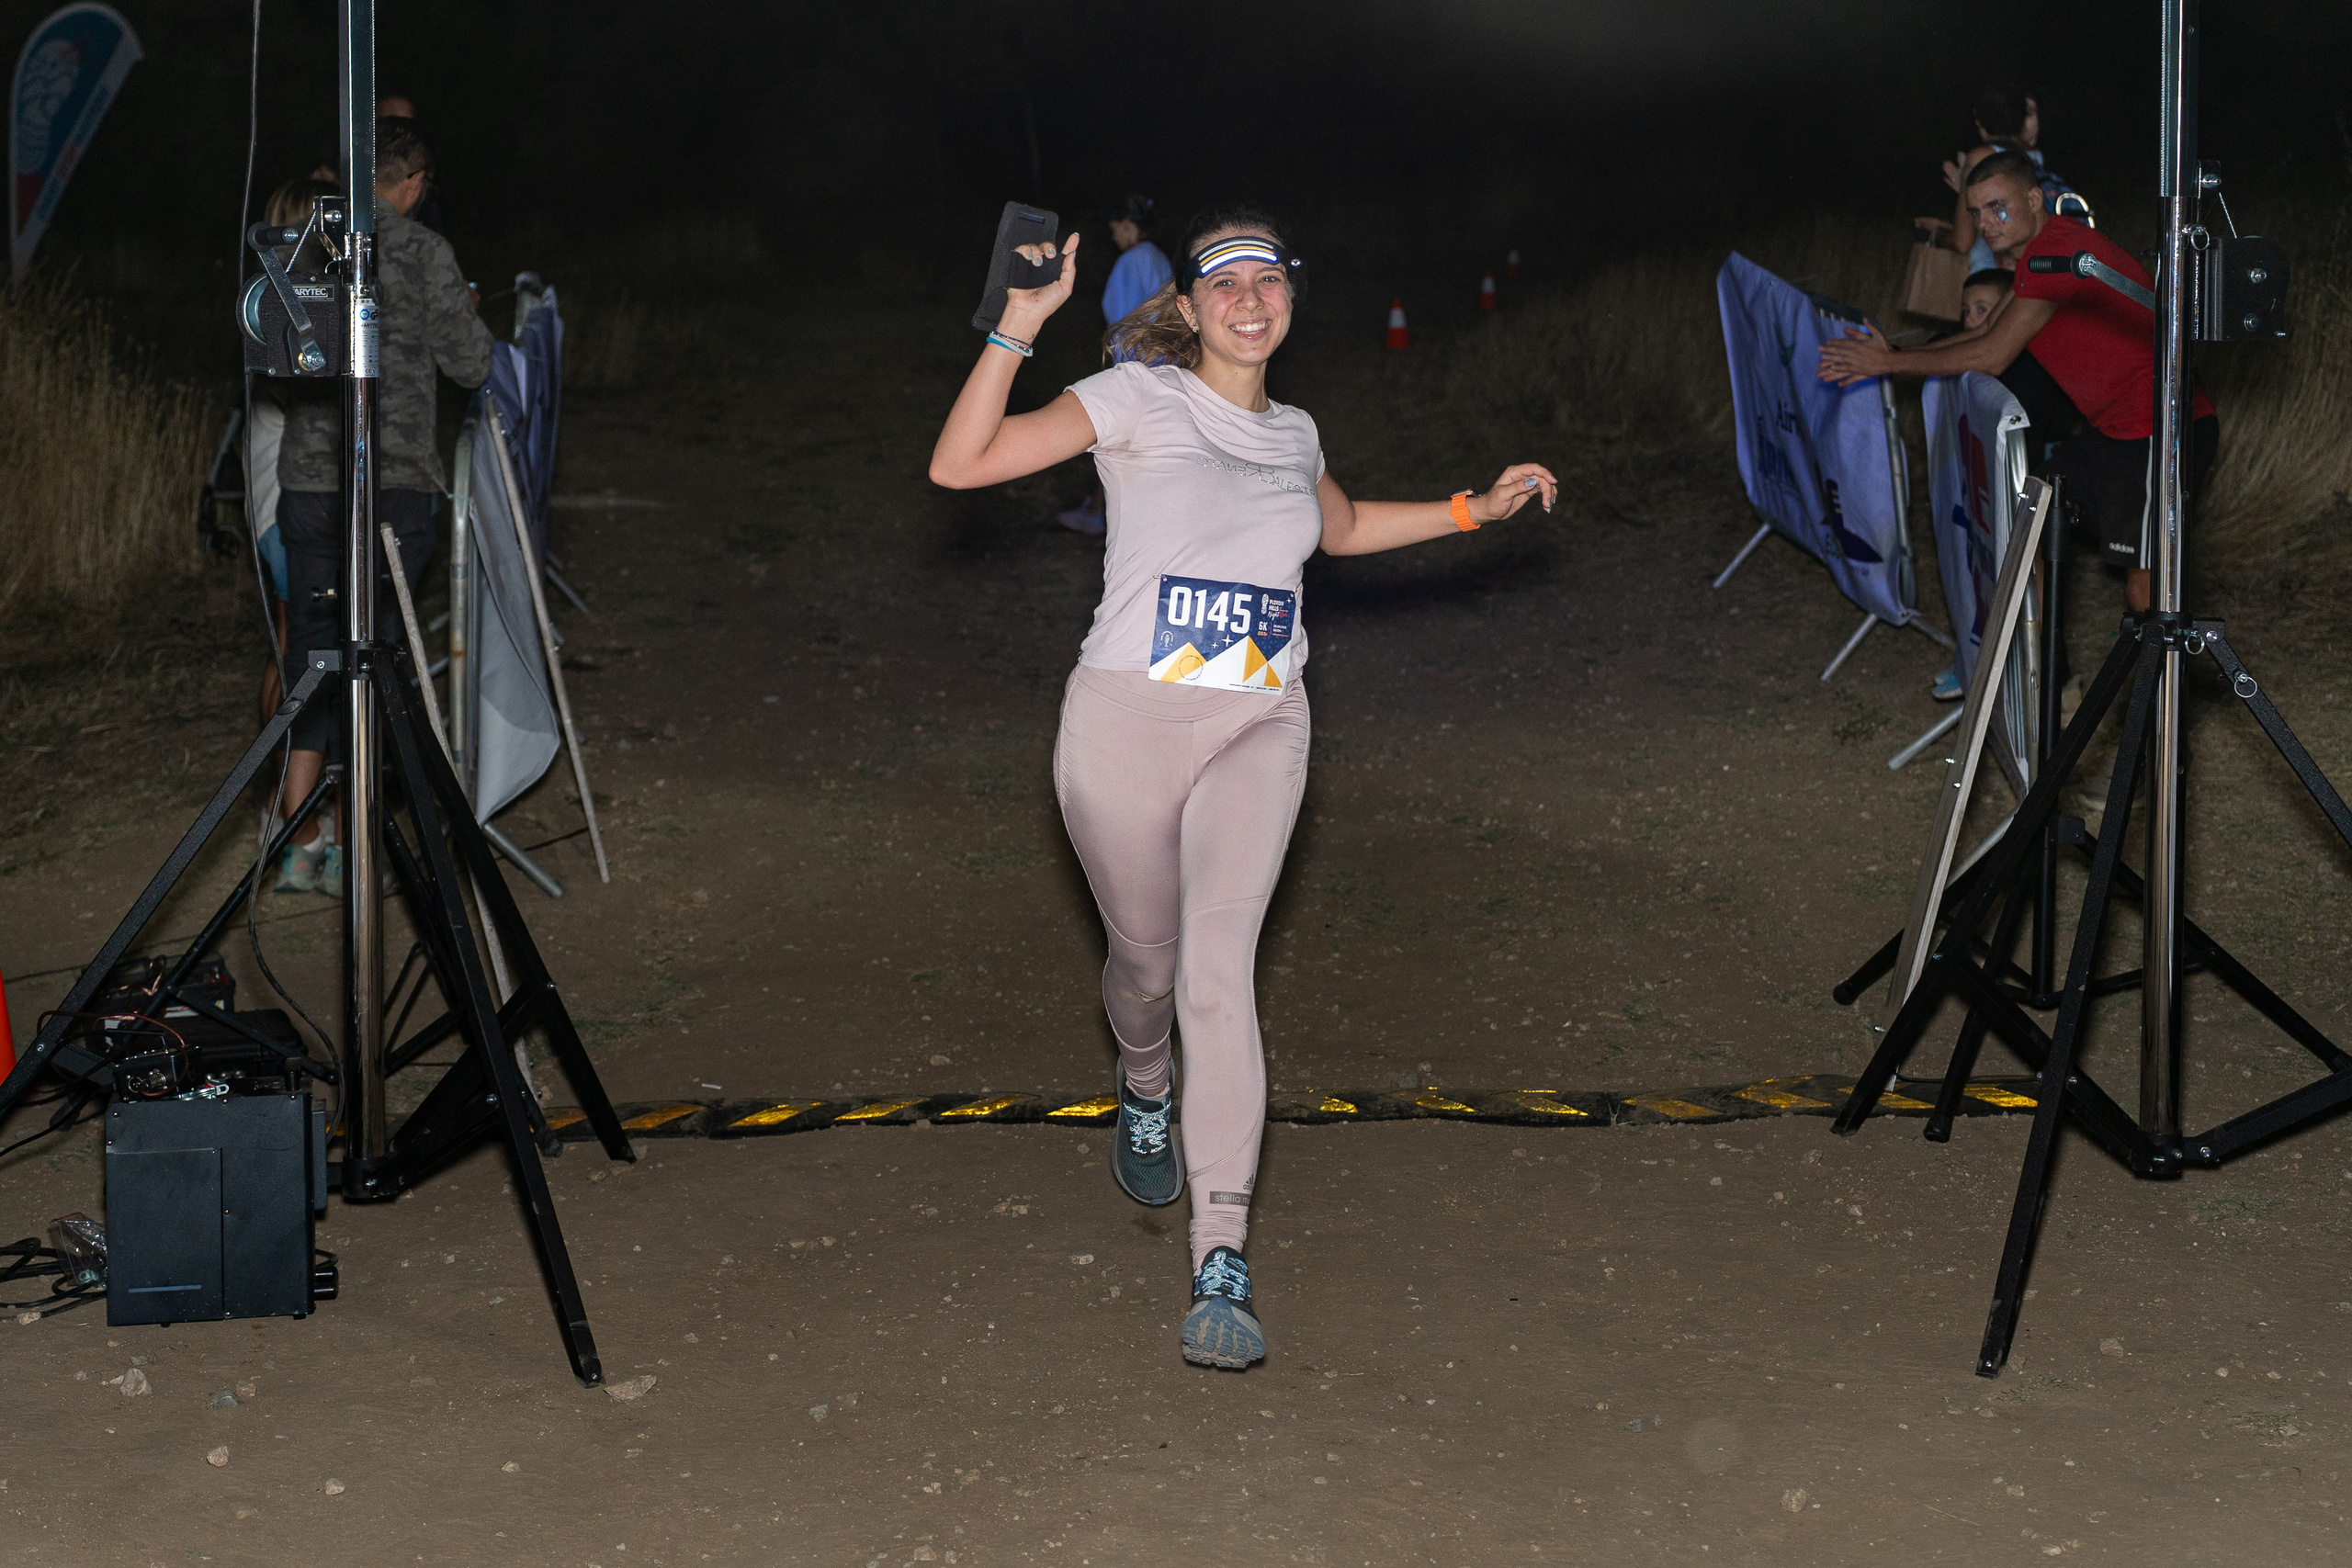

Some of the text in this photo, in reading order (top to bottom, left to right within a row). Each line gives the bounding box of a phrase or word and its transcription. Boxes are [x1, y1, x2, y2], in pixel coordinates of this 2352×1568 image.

[293, 288, 327, 296] ARYTEC
[1167, 586, 1253, 635] 0145
[1258, 621, 1268, 631] 6K
[1215, 1193, 1241, 1203] stella
